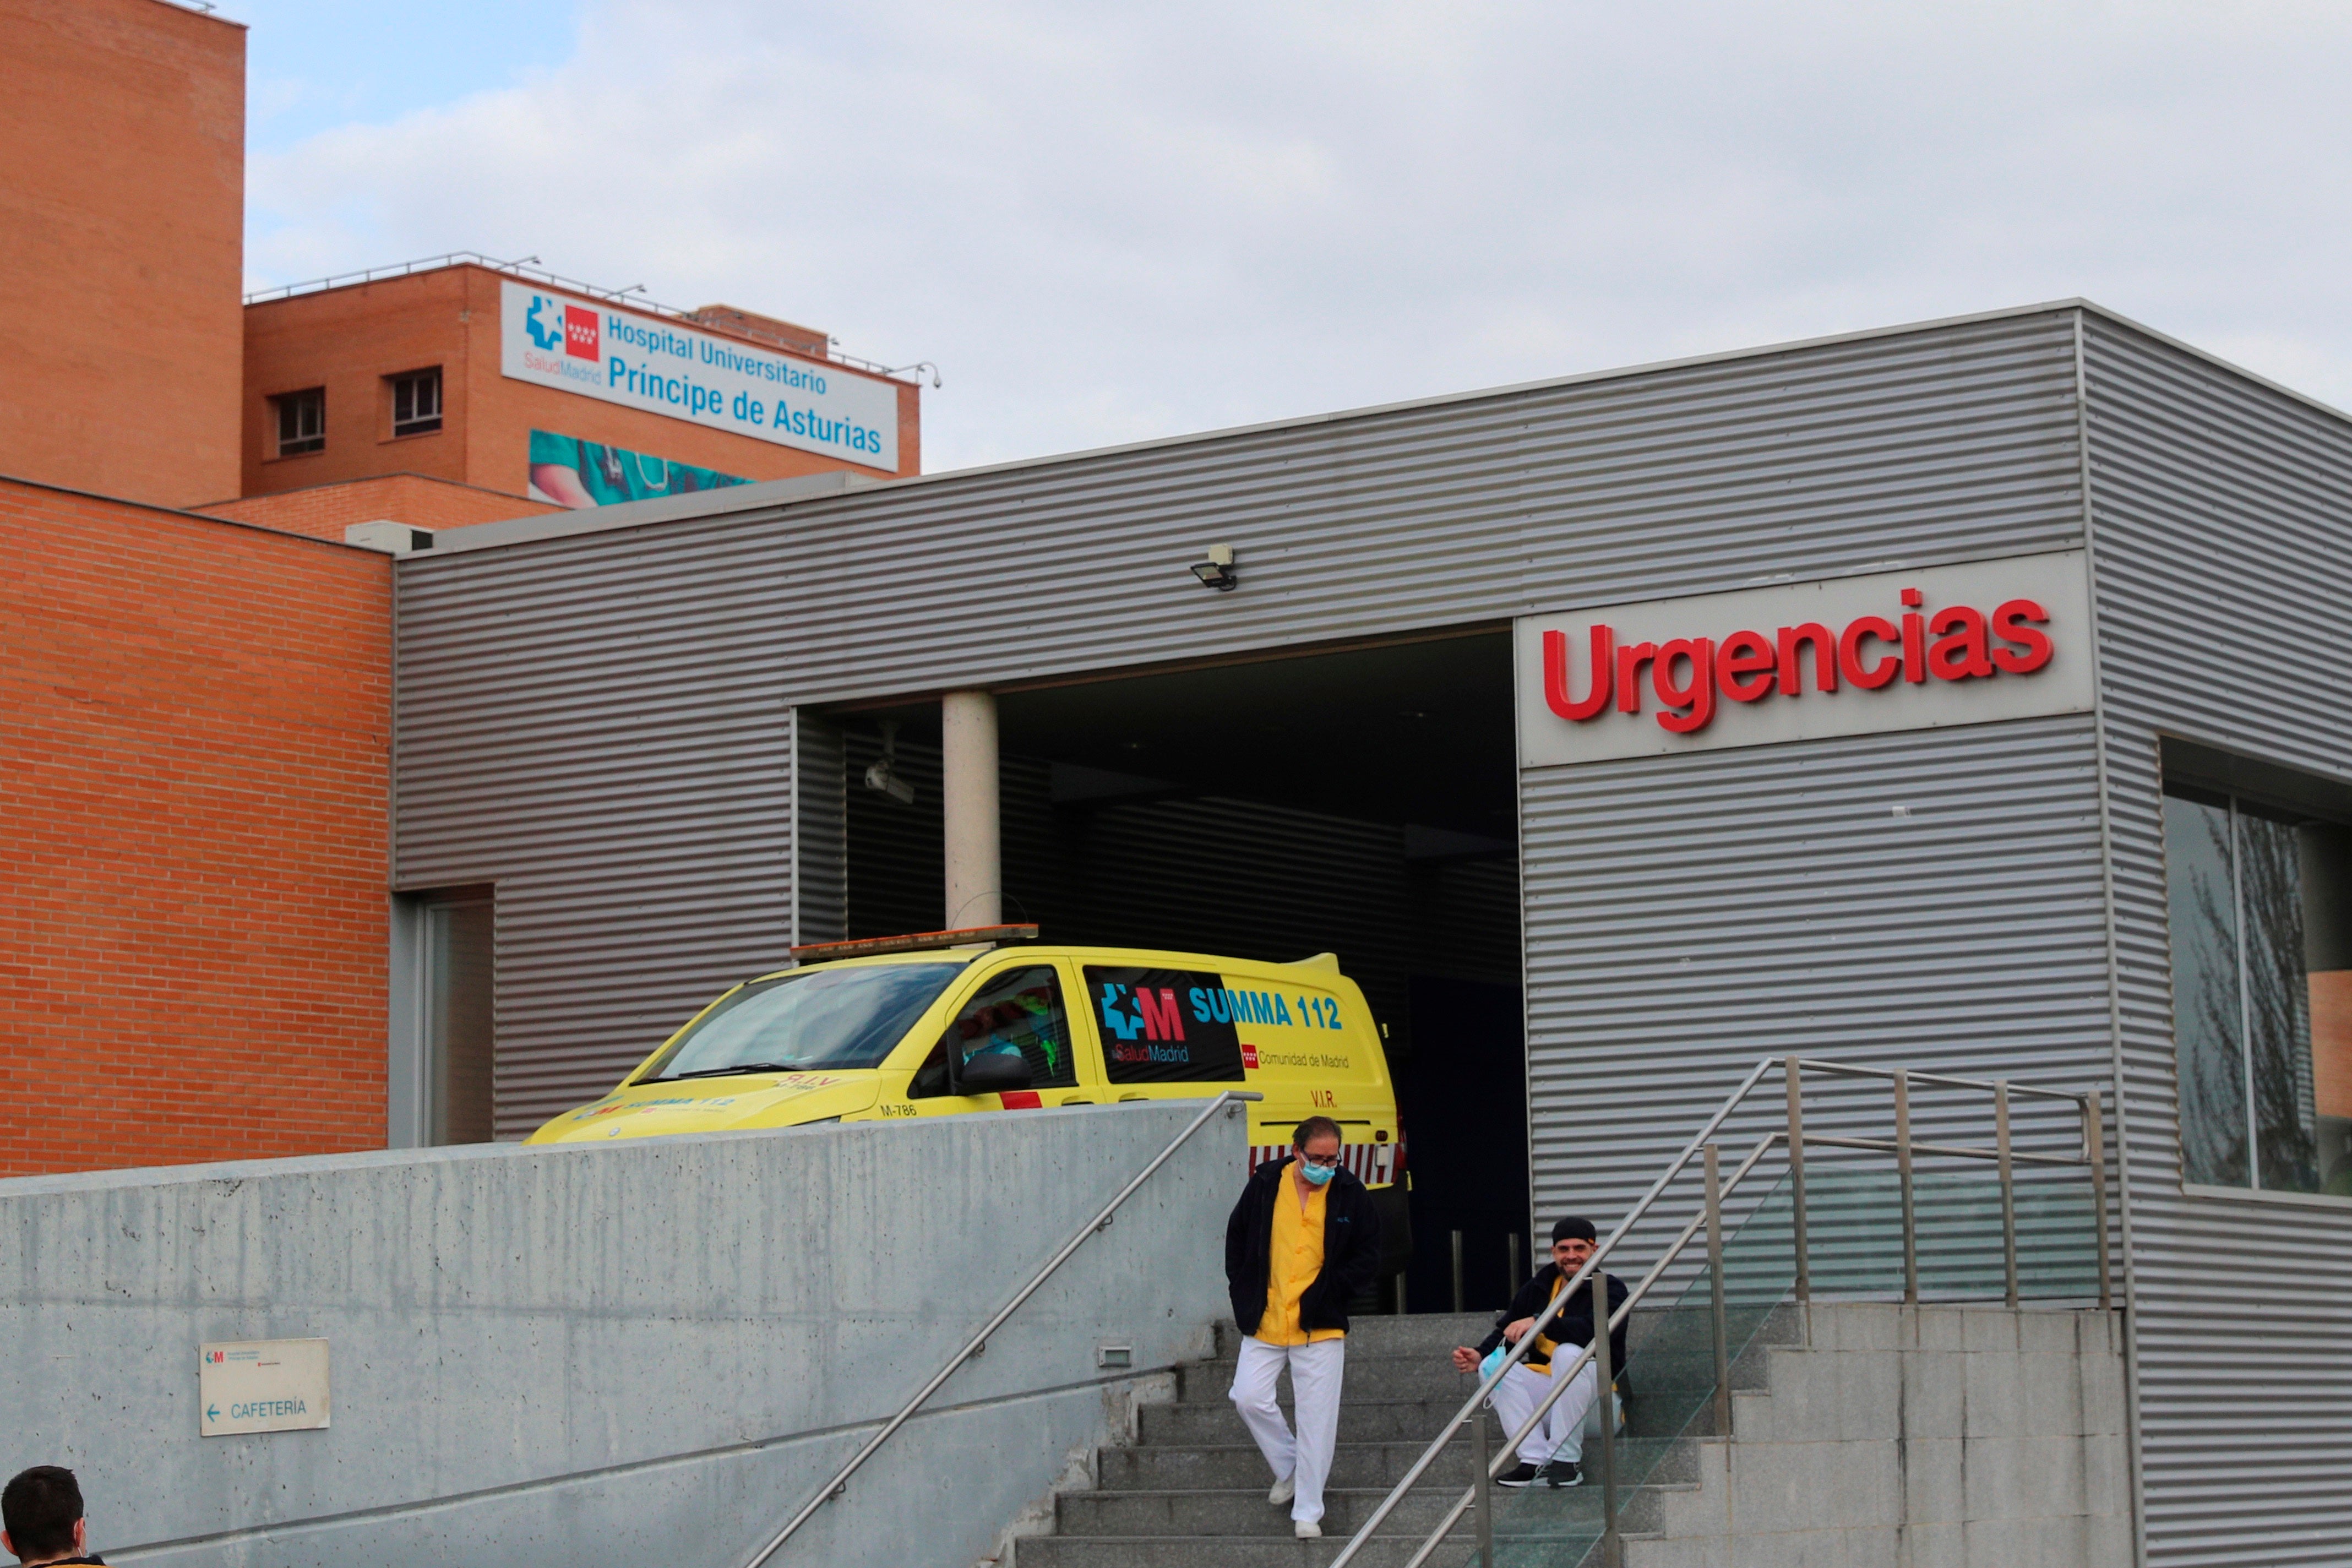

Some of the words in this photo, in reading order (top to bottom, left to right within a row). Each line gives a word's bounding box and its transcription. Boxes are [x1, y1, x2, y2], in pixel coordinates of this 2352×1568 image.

[525, 351, 602, 385] SaludMadrid
[608, 315, 693, 360] Hospital
[701, 342, 826, 395] Universitario
[609, 356, 723, 416] Príncipe
[733, 390, 764, 424] de
[774, 400, 881, 454] Asturias
[1542, 587, 2055, 733] Urgencias
[1189, 987, 1293, 1026] SUMMA
[1297, 995, 1343, 1030] 112
[1114, 1043, 1189, 1063] SaludMadrid
[1259, 1050, 1308, 1066] Comunidad
[1309, 1054, 1320, 1067] de
[1320, 1054, 1349, 1069] Madrid
[880, 1104, 918, 1117] M-786
[1310, 1089, 1337, 1108] V.I.R.
[231, 1396, 307, 1419] CAFETERÍA
